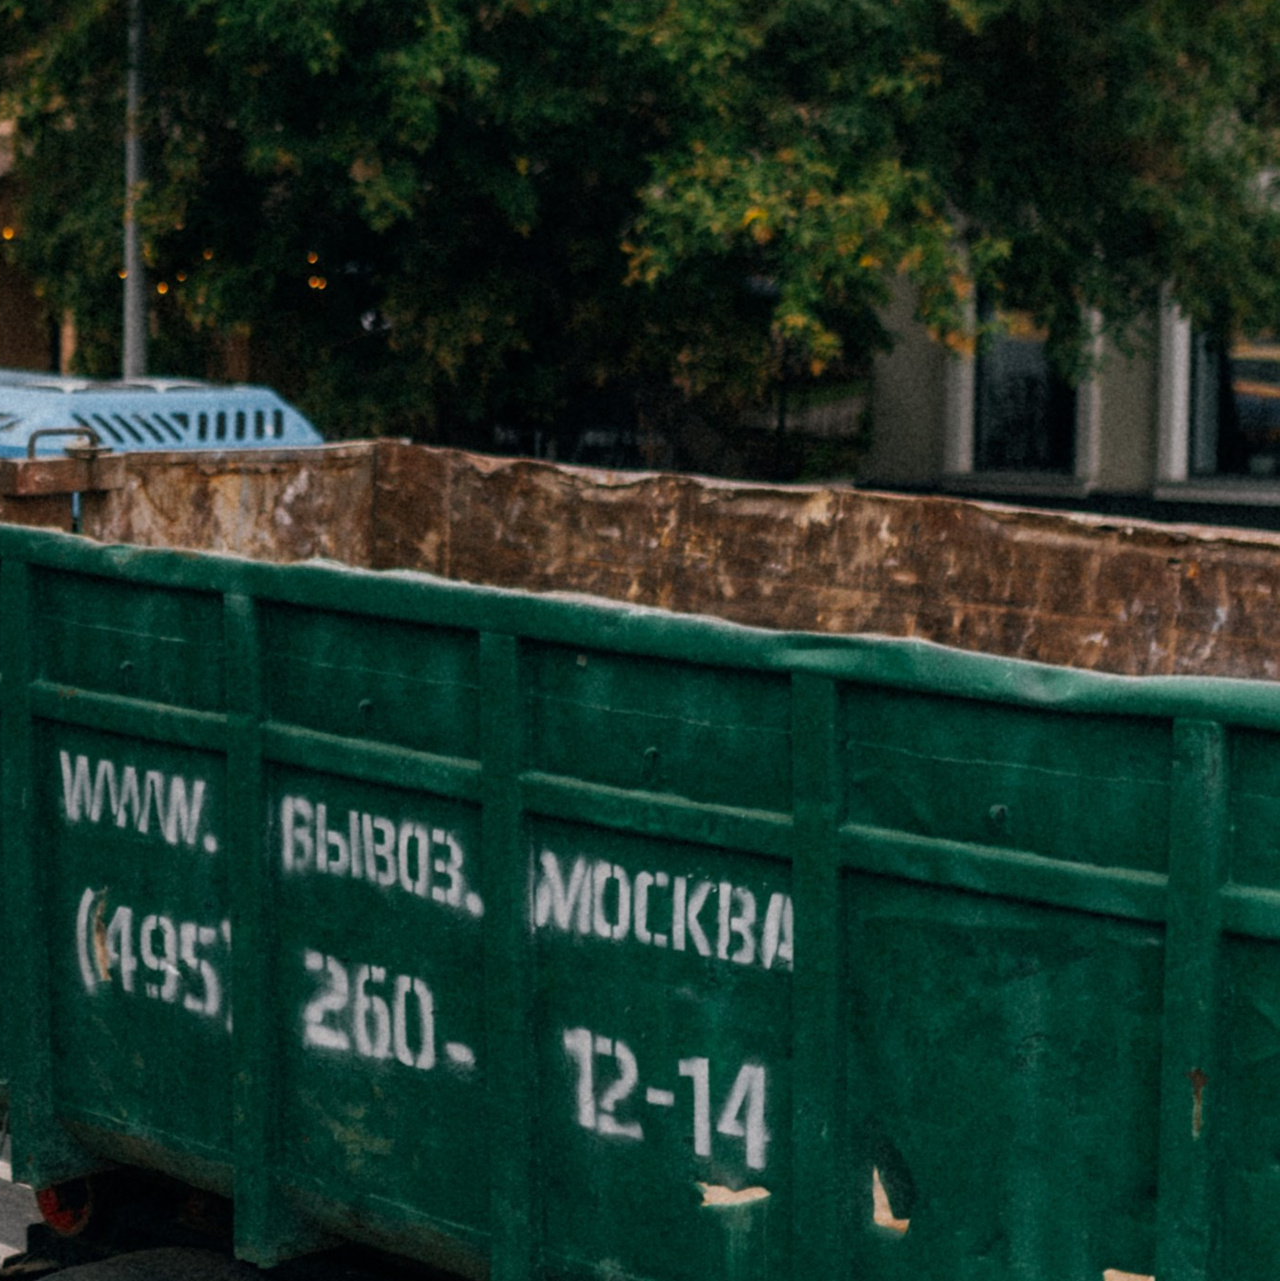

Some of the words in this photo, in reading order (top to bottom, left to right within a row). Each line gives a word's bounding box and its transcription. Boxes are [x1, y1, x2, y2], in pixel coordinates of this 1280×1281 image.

[60, 749, 217, 854] WWW.
[280, 794, 484, 918] ВЫВОЗ.
[534, 850, 794, 972] МОСКВА
[75, 886, 232, 1032] (495
[302, 950, 475, 1071] 260-
[562, 1026, 771, 1171] 12-14
